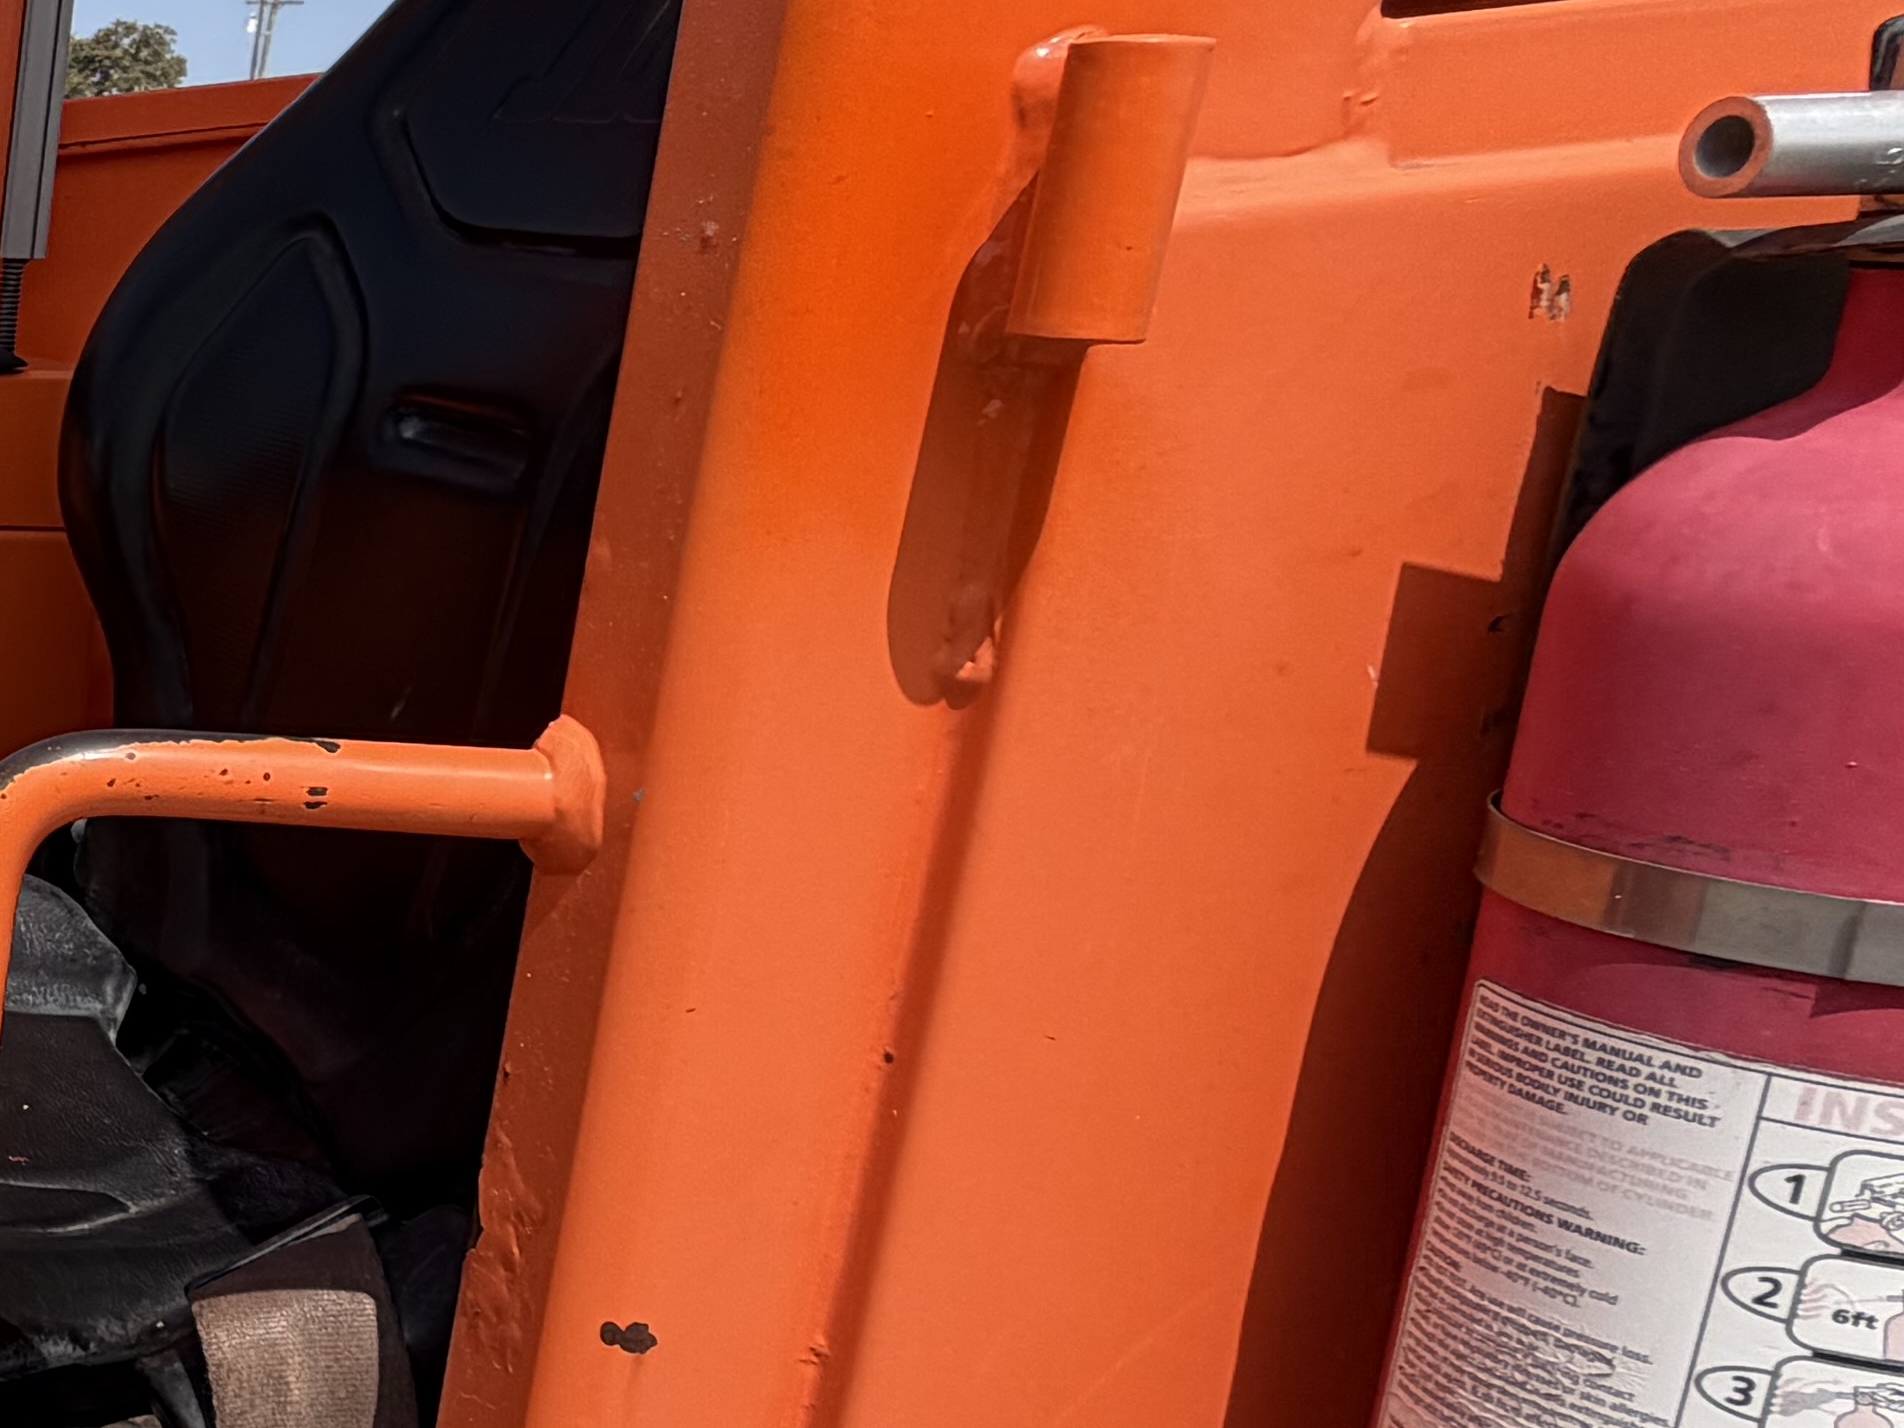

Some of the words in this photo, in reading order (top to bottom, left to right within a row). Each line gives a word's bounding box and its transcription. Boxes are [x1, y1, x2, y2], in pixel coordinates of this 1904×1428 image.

[1520, 1015, 1580, 1045] OWNER'S
[1582, 1037, 1656, 1068] MANUAL
[1659, 1059, 1703, 1079] AND
[1545, 1039, 1591, 1065] LABEL.
[1595, 1057, 1642, 1079] READ
[1645, 1071, 1679, 1089] ALL
[1497, 1049, 1555, 1081] IMPROPER
[1557, 1073, 1586, 1092] USE
[1589, 1085, 1646, 1109] COULD
[1650, 1102, 1722, 1129] RESULT
[1507, 1083, 1569, 1115] DAMAGE.
[1516, 1072, 1561, 1097] BODILY
[1564, 1091, 1619, 1116] INJURY
[1622, 1110, 1650, 1127] OR
[1520, 1047, 1548, 1064] AND
[1551, 1057, 1629, 1090] CAUTIONS
[1633, 1083, 1663, 1099] ON
[1666, 1091, 1709, 1111] THIS
[1520, 1184, 1542, 1202] 12.5
[1785, 1174, 1806, 1204] 1
[1471, 1179, 1554, 1226] PRECAUTIONS
[1557, 1217, 1646, 1256] WARNING:
[1752, 1277, 1781, 1309] 2
[1831, 1309, 1879, 1331] 6ft
[1725, 1373, 1756, 1406] 3
